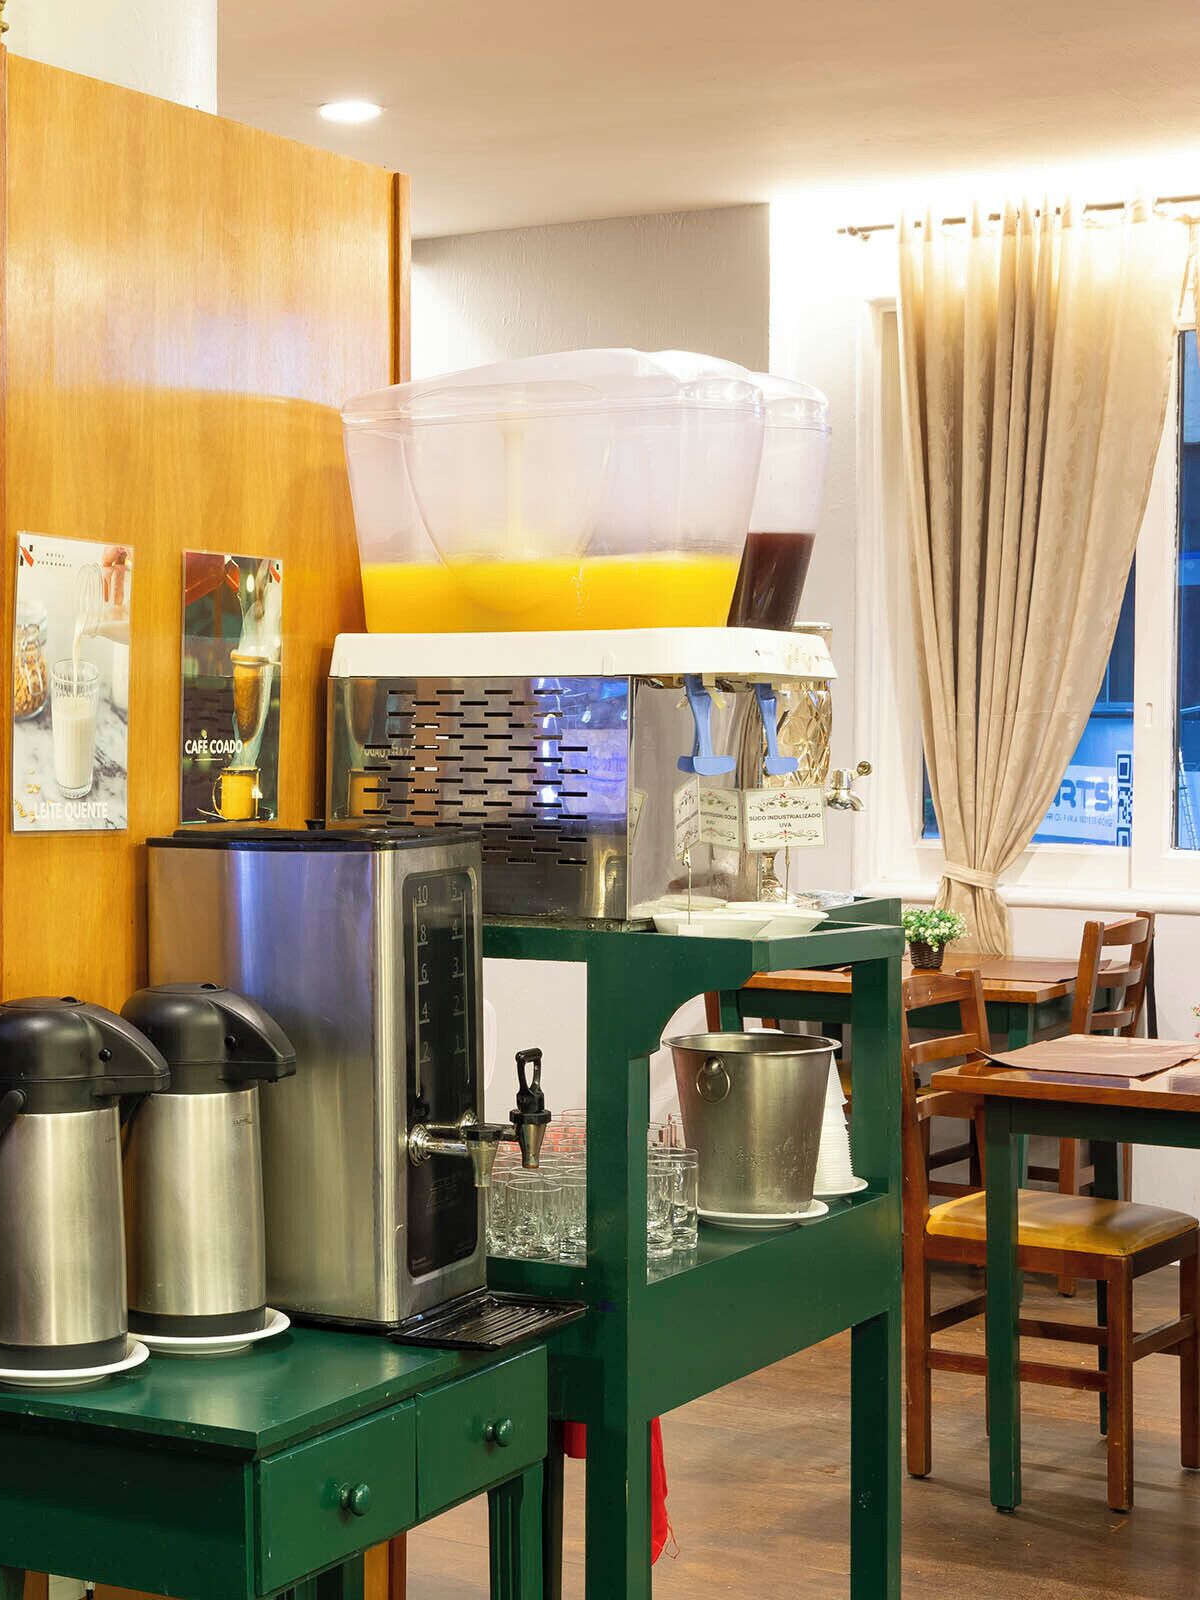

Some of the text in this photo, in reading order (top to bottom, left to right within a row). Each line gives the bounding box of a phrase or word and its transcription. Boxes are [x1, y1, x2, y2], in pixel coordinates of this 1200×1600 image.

[184, 736, 243, 755] CAFÉ COADO
[34, 801, 109, 819] LEITE QUENTE
[767, 812, 821, 821] INDUSTRIALIZADO
[417, 885, 429, 903] 10
[420, 924, 427, 941] 8
[421, 963, 428, 981] 6
[421, 1001, 428, 1020] 4
[422, 1041, 429, 1060] 2
